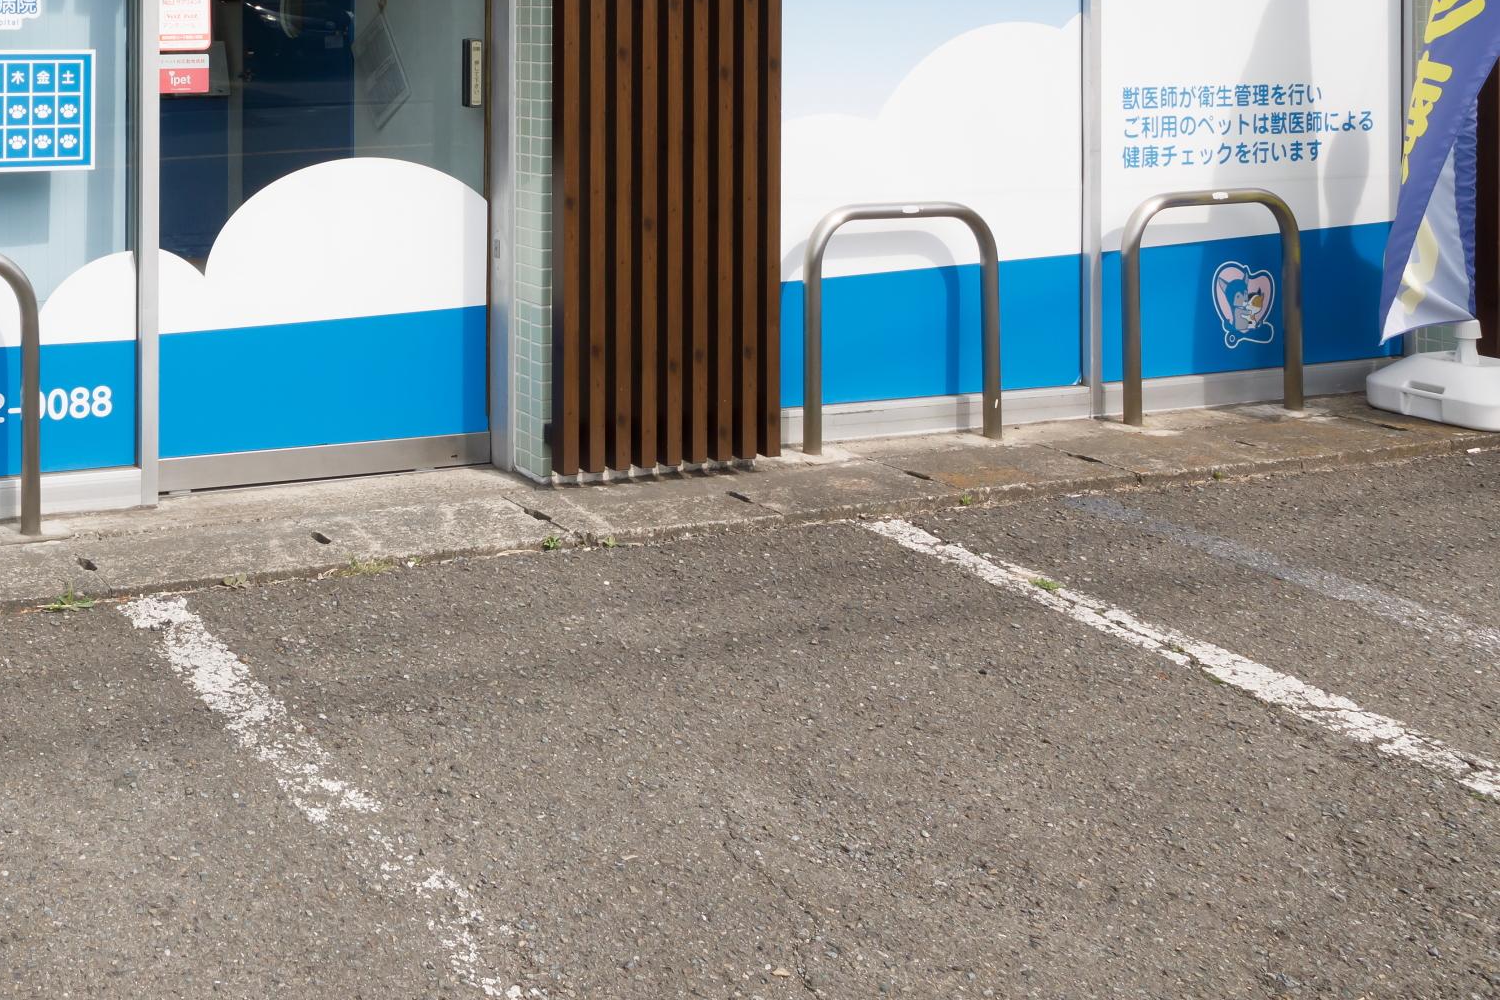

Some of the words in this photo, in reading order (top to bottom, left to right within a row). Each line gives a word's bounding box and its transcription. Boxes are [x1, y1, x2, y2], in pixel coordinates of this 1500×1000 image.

[11, 71, 25, 85] 木
[36, 70, 50, 85] 金
[62, 71, 75, 85] 土
[169, 71, 191, 87] ipet
[1122, 84, 1322, 110] 獣医師が衛生管理を行い
[1123, 111, 1373, 138] ご利用のペットは獣医師による
[1122, 139, 1323, 168] 健康チェックを行います
